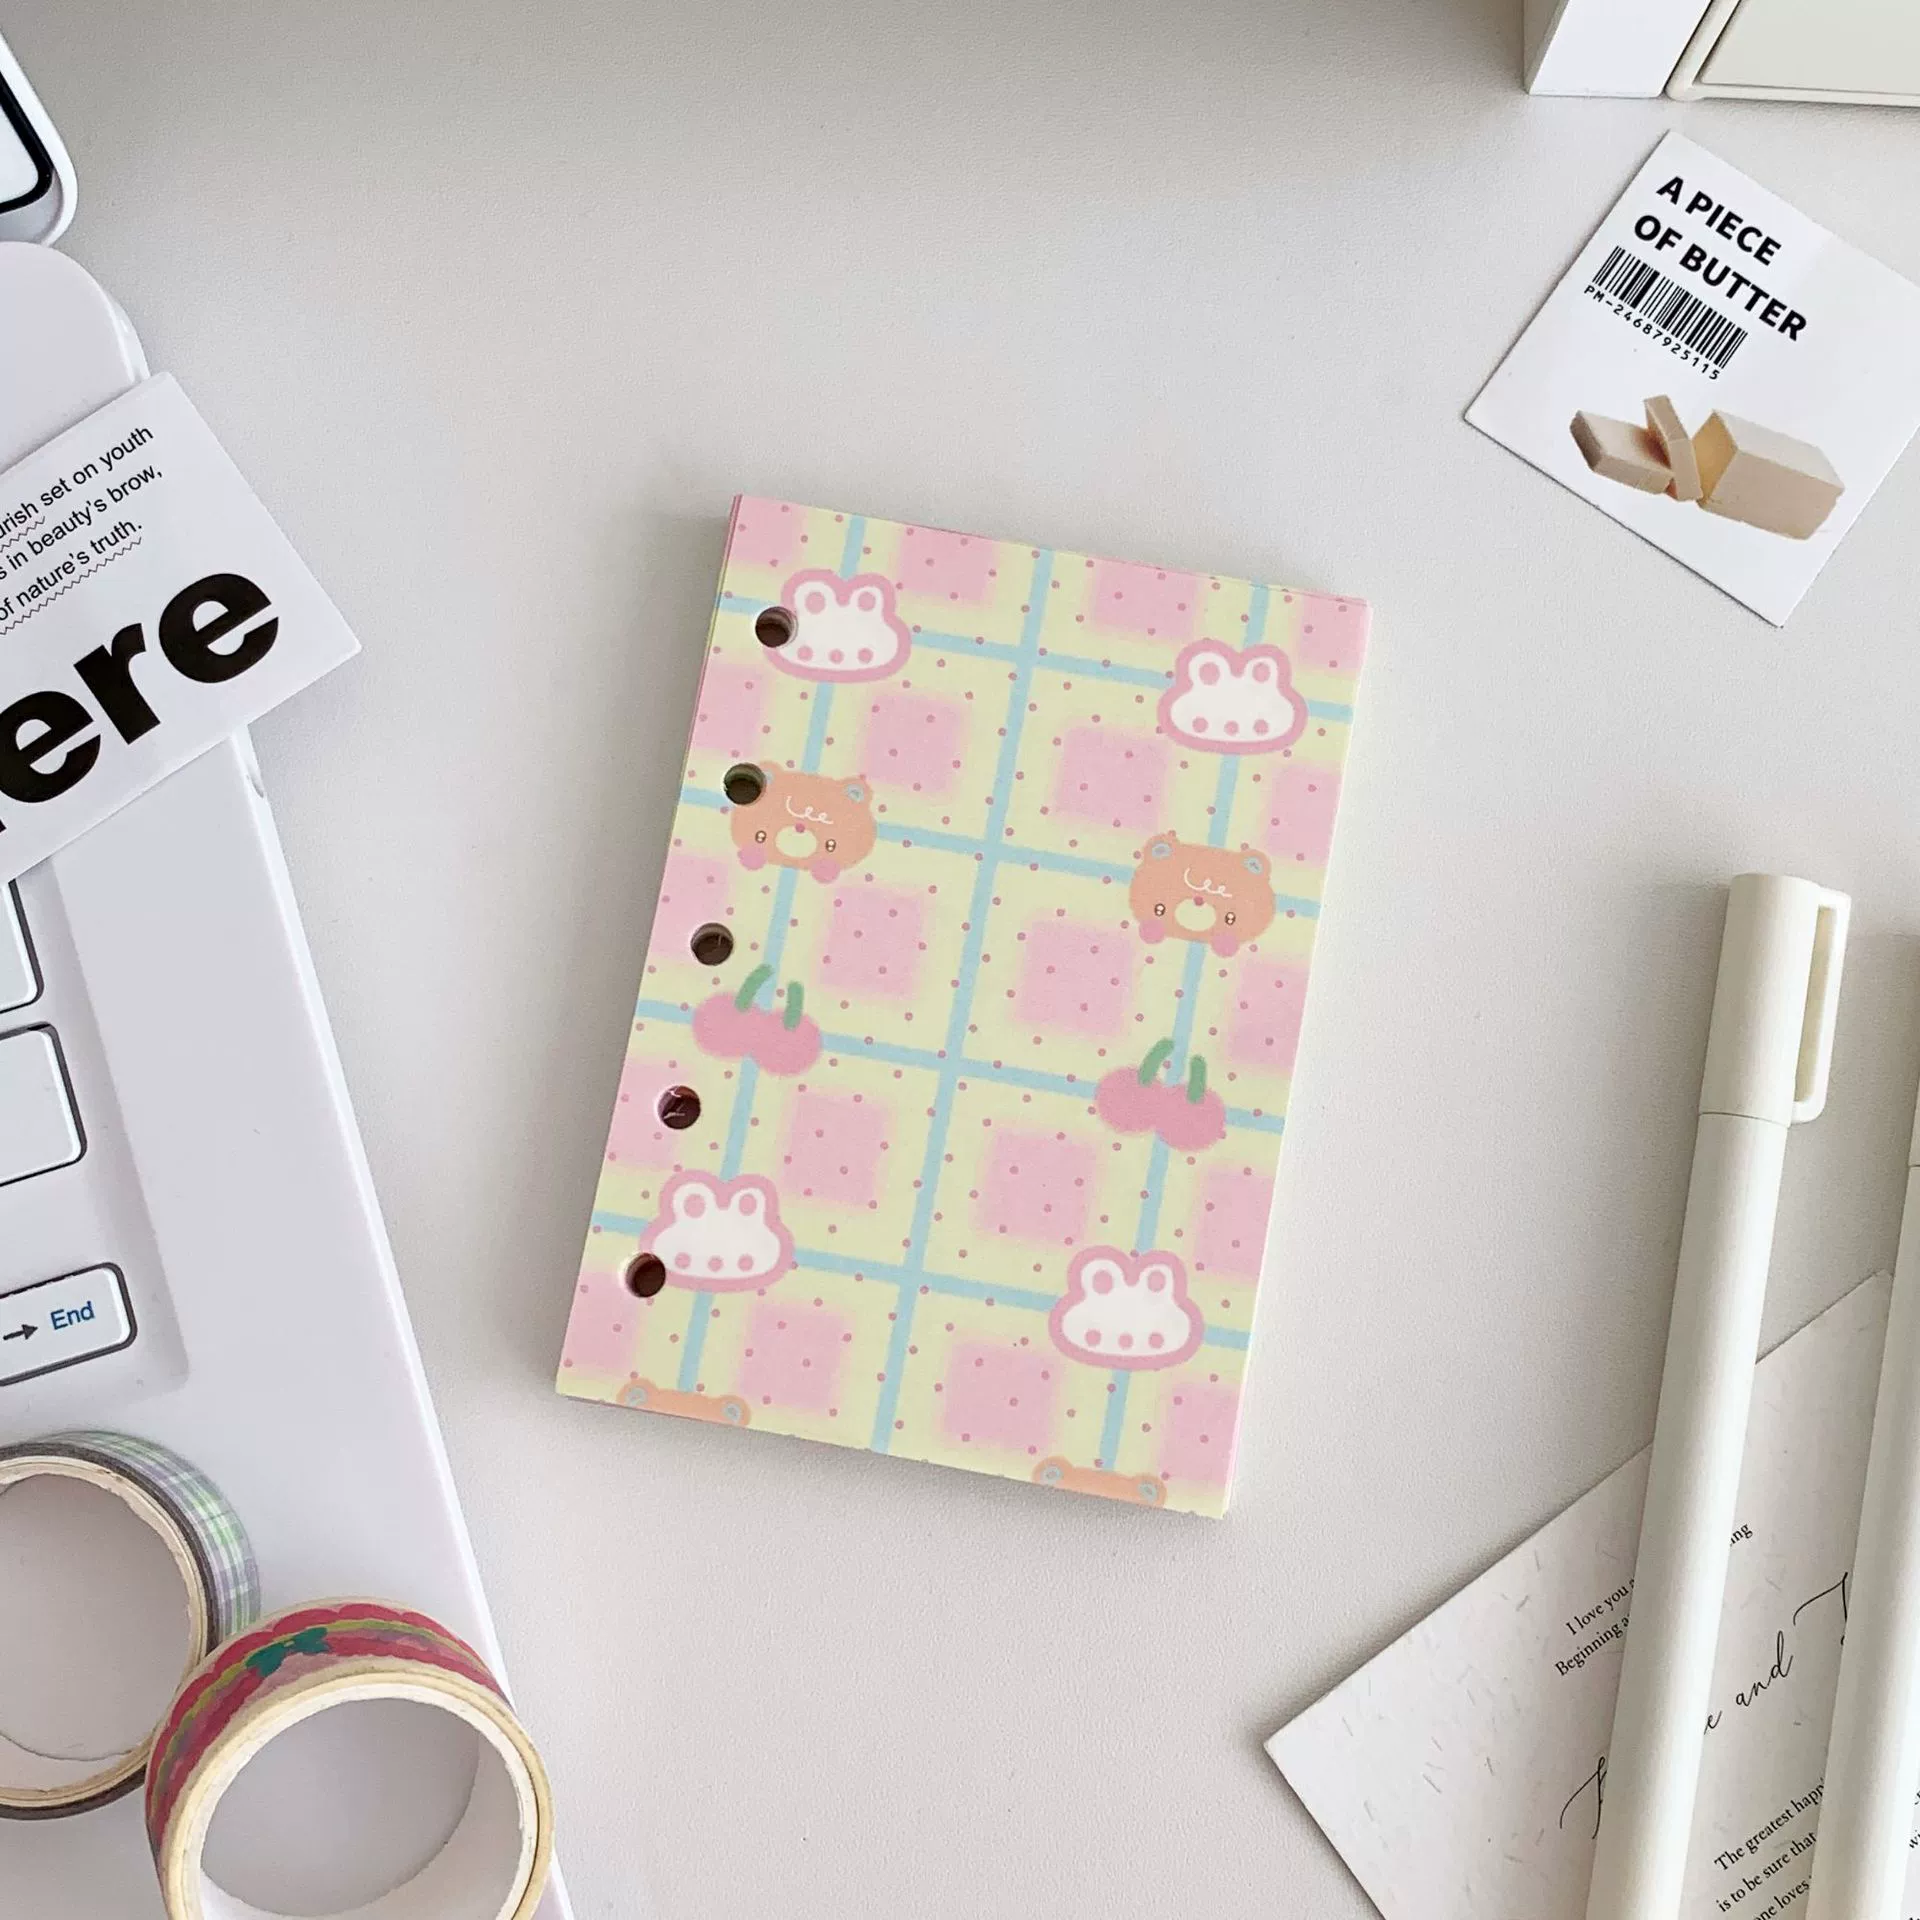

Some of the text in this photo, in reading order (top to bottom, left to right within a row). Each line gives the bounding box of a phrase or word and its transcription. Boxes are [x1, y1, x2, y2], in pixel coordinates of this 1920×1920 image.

[1655, 175, 1782, 266] A PIECE
[1633, 214, 1807, 342] OF BUTTER
[1583, 284, 1720, 380] PM-24687925115
[40, 477, 73, 507] set
[72, 463, 99, 485] on
[99, 426, 154, 472] youth
[6, 551, 29, 571] in
[27, 498, 108, 556] beauty's
[106, 464, 163, 503] brow,
[0, 518, 143, 621] of nature's truth.
[0, 573, 279, 833] ere
[50, 1300, 95, 1330] End
[1554, 1623, 1624, 1677] Beginning
[1565, 1585, 1630, 1636] I love you
[1735, 1630, 1794, 1707] and
[1713, 1777, 1825, 1871] The greatest happ
[1715, 1898, 1732, 1913] is
[1730, 1887, 1746, 1903] to
[1741, 1875, 1764, 1892] be
[1762, 1852, 1792, 1879] sure
[1754, 1880, 1810, 1920] ne loves
